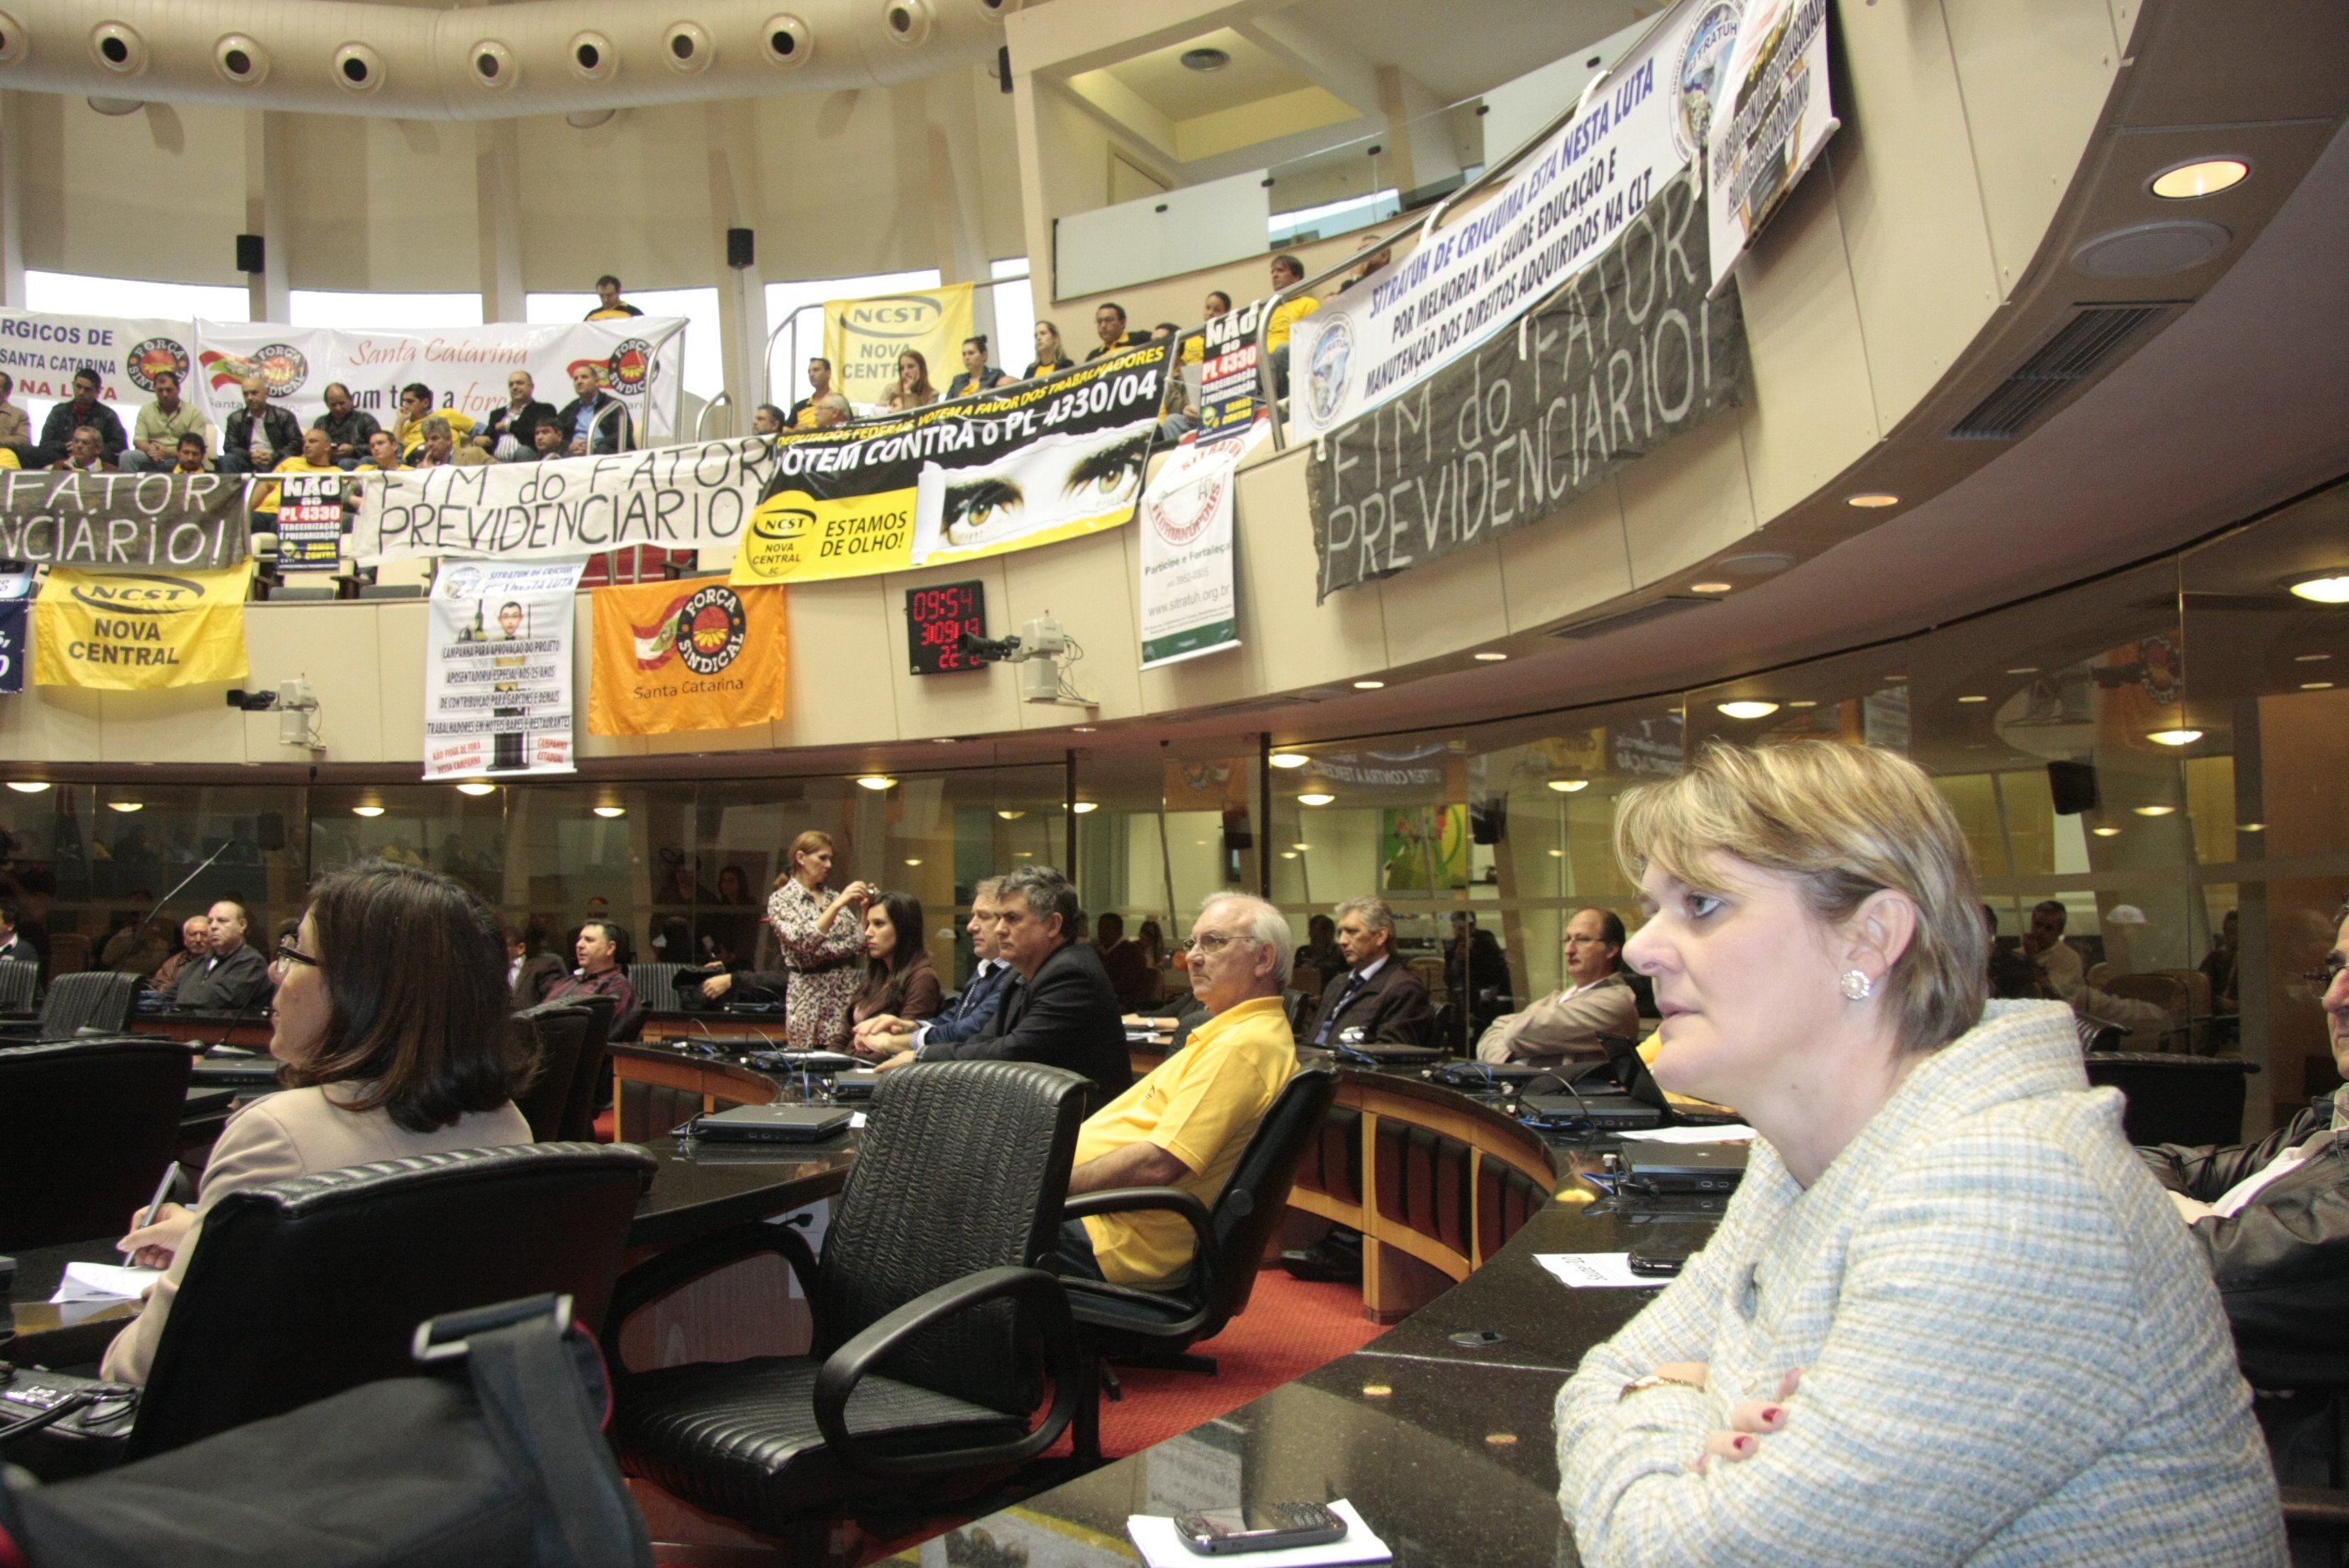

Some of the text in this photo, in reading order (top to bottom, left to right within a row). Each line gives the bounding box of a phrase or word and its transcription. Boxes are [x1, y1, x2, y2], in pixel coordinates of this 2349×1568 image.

[1370, 249, 1431, 319] SITRATUH
[1433, 235, 1455, 274] DE
[1527, 148, 1558, 205] ESTA
[1562, 100, 1610, 172] NESTA
[1614, 57, 1653, 126] LUTA
[1392, 305, 1415, 344] POR
[1417, 264, 1479, 327] MELHORIA
[1481, 249, 1498, 288] NA
[1537, 155, 1605, 240] EDUCAÇÃO
[1608, 146, 1617, 184] E
[1364, 326, 1436, 400] MANUTENÇÃO
[1438, 312, 1462, 354] DOS
[1463, 271, 1517, 337] DIREITOS
[1518, 209, 1601, 300] ADQUIRIDOS
[1603, 190, 1623, 236] NA
[1628, 168, 1652, 215] CLT
[853, 306, 926, 324] NCST
[88, 329, 113, 346] DE
[349, 338, 529, 366] Santa Catarina
[861, 344, 910, 359] NOVA
[50, 355, 117, 375] CATARINA
[1201, 345, 1257, 382] PL 4330
[19, 379, 52, 395] NA
[777, 430, 850, 449] DEPUTADOS
[918, 406, 962, 426] VOTEM
[961, 405, 973, 416] A
[973, 396, 1021, 415] FAVOR
[1021, 386, 1047, 407] DOS
[1047, 346, 1166, 395] TRABALHADORES
[442, 389, 455, 410] a
[864, 420, 976, 466] CONTRA
[1005, 409, 1038, 442] PL
[1042, 369, 1158, 428] 4330/04
[1335, 380, 1432, 505] FIM
[1457, 354, 1512, 450] do
[381, 437, 769, 509] FIM do FATOR
[7, 472, 220, 515] FATOR
[283, 476, 341, 498] NÃO
[280, 505, 341, 521] PL 4330
[765, 517, 807, 531] NCST
[825, 510, 908, 538] ESTAMOS
[765, 543, 794, 554] NOVA
[820, 532, 904, 558] DE OLHO!
[752, 554, 801, 565] CENTRAL
[90, 585, 186, 601] NCST
[685, 588, 737, 617] FORÇA
[94, 618, 161, 641] NOVA
[68, 641, 180, 666] CENTRAL
[442, 646, 474, 660] CAMPANHA
[475, 645, 490, 658] PARA
[525, 641, 535, 655] DO
[535, 640, 561, 654] PROJETO
[677, 632, 745, 674] SINDICAL
[633, 686, 678, 700] Santa
[682, 678, 744, 694] Catarina
[440, 697, 448, 709] DE
[427, 721, 475, 735] TRABALHADORES
[529, 715, 571, 730] RESTAURANTES
[460, 744, 468, 755] DE
